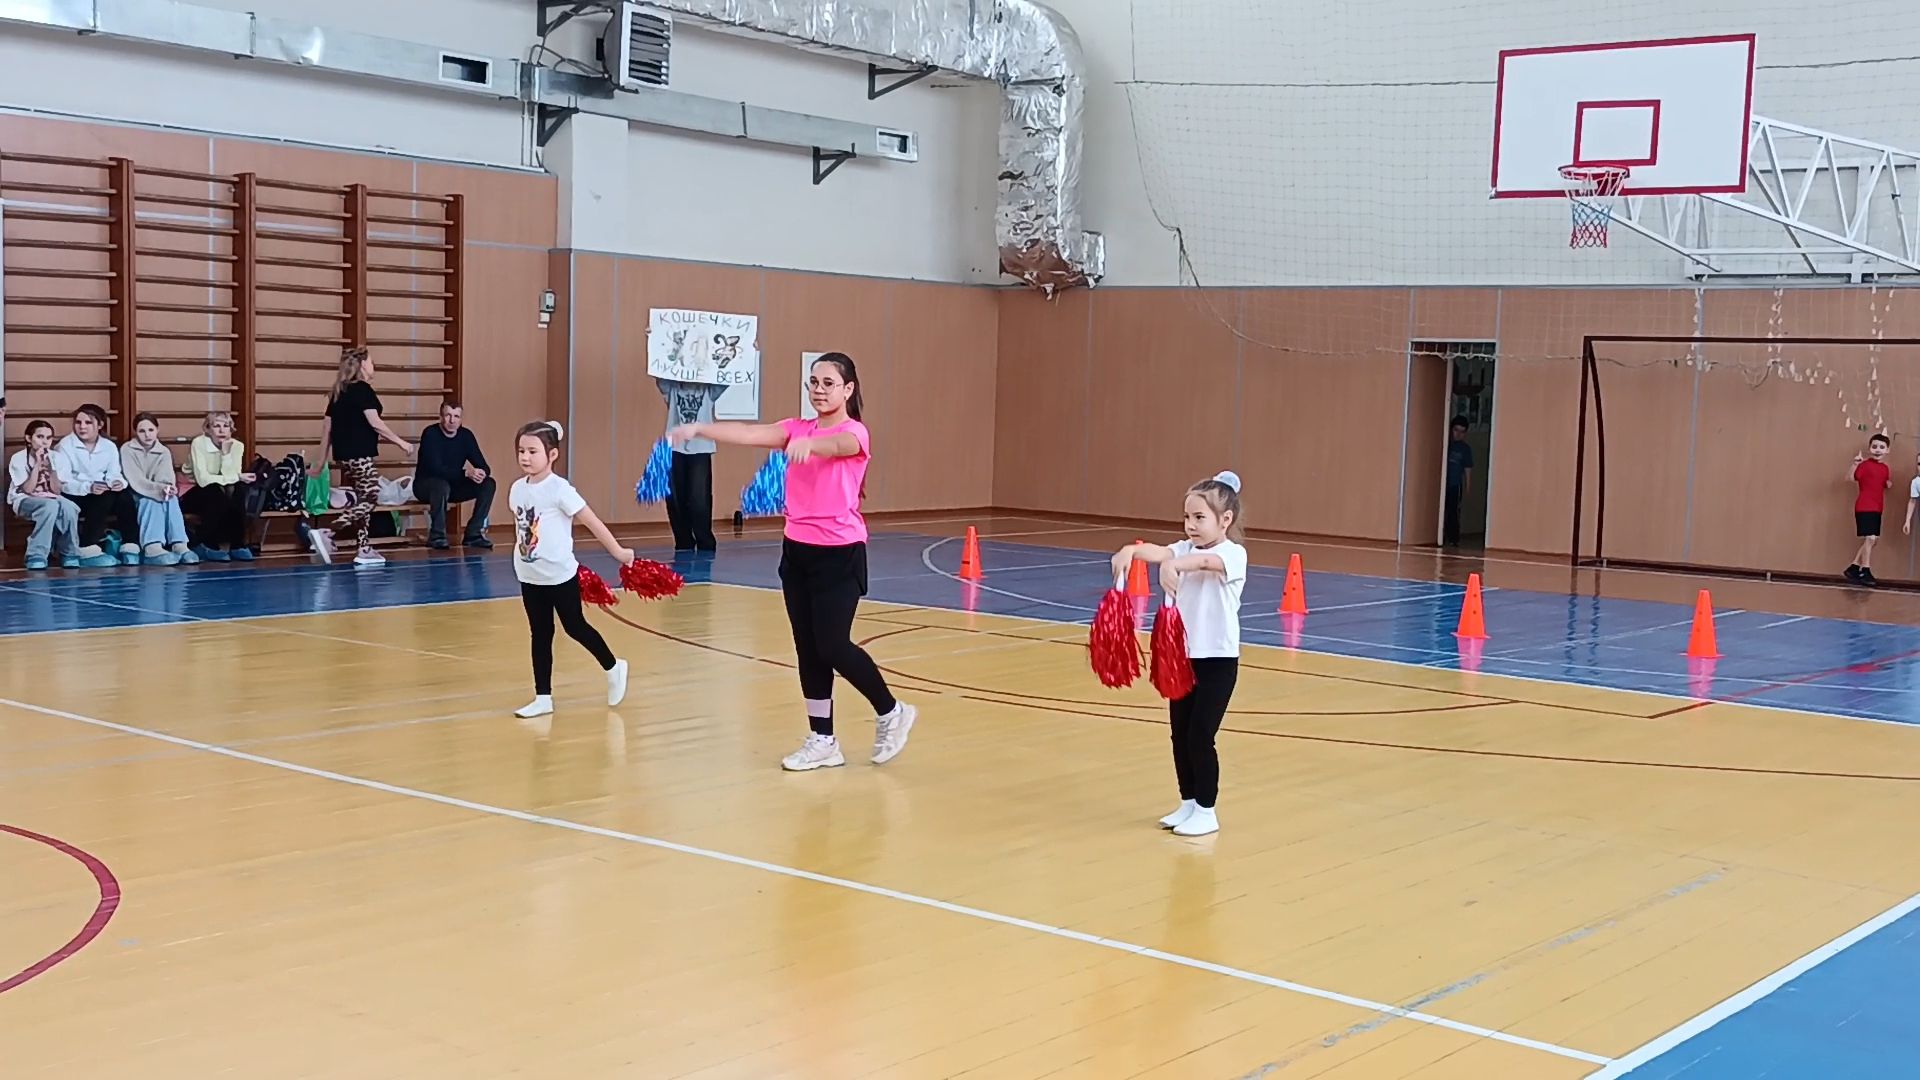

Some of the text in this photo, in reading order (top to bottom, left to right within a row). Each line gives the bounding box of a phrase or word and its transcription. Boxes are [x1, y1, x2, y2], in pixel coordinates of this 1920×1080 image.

[659, 311, 751, 332] КОШЕЧКИ
[652, 359, 755, 384] ЛУЧШЕ ВСЕХ
